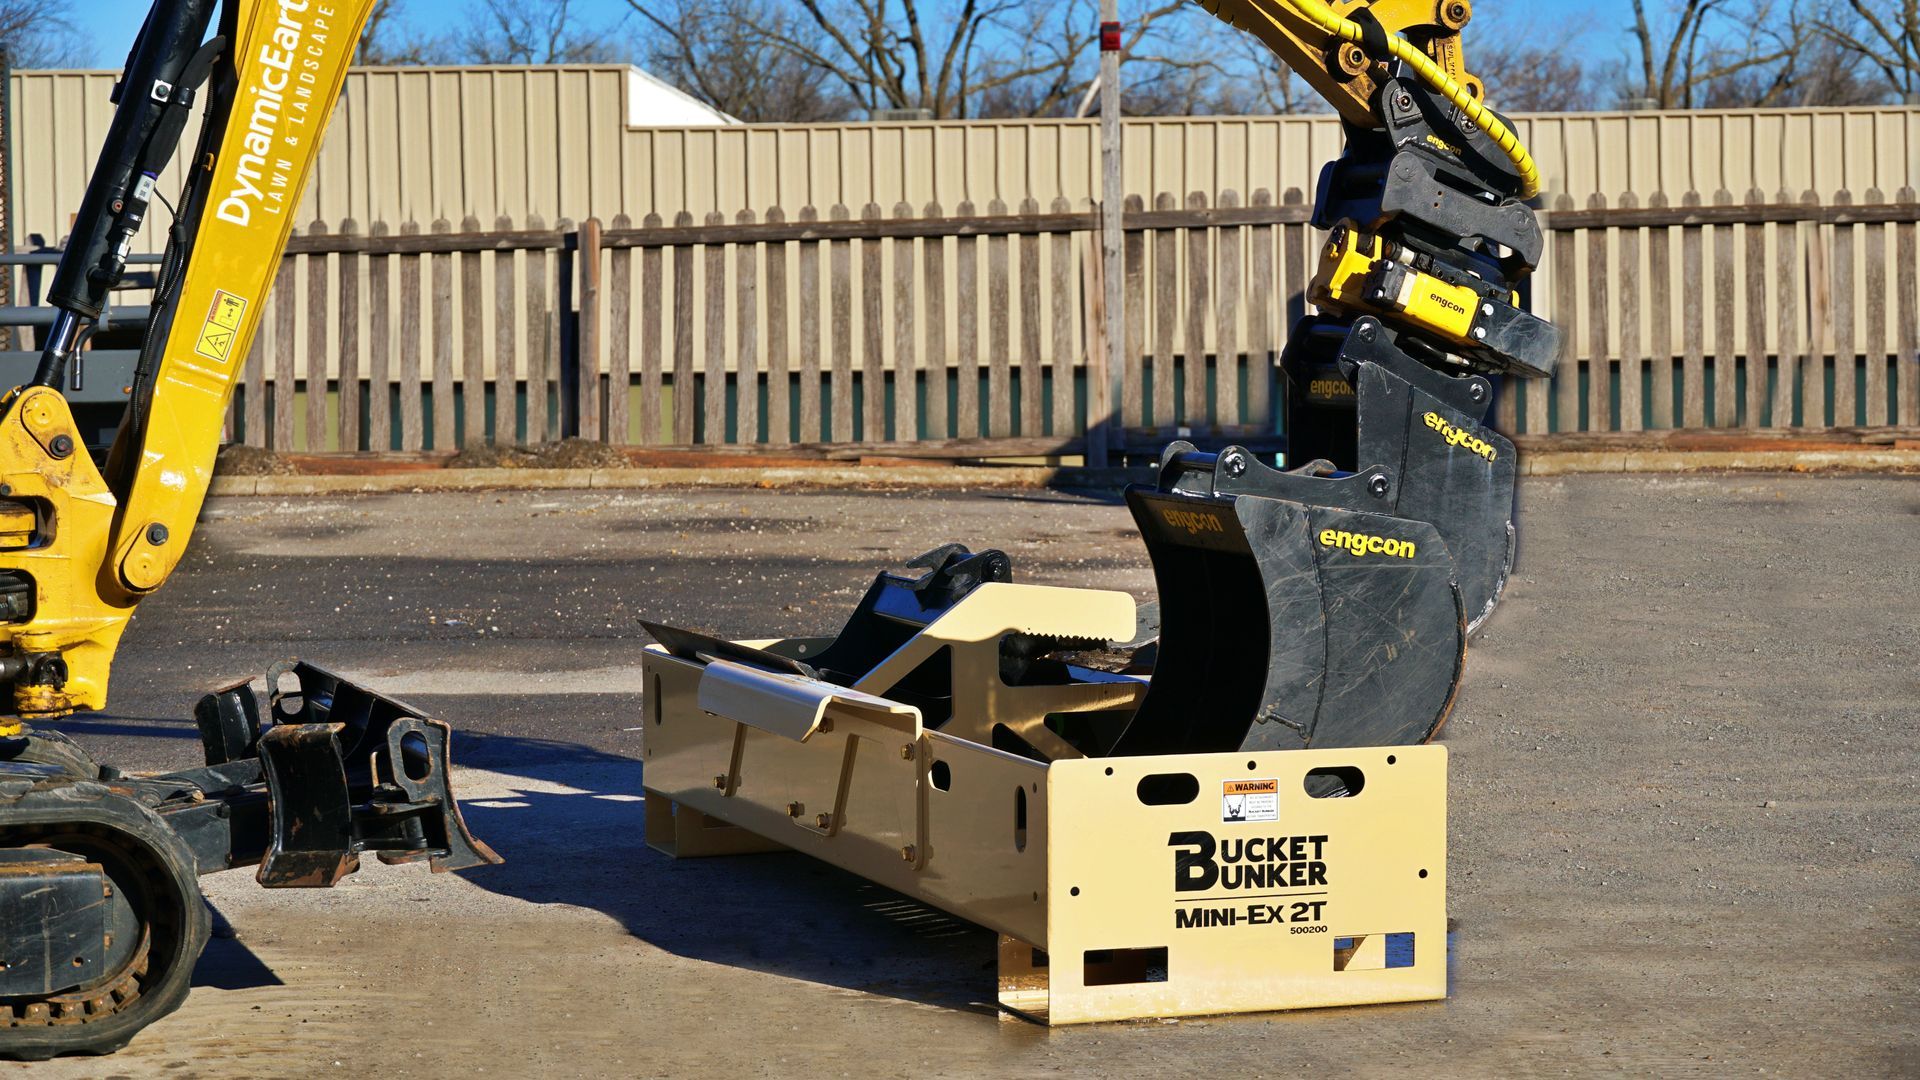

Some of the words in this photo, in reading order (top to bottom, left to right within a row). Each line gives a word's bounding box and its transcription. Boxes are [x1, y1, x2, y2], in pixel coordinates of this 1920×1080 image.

[288, 5, 334, 124] LANDSCAPE
[216, 0, 309, 227] DynamicEart
[285, 137, 298, 146] &
[1426, 134, 1462, 156] engcon
[263, 159, 293, 214] LAWN
[1430, 293, 1465, 315] engcon
[1423, 412, 1497, 461] engcon
[1162, 509, 1224, 535] engcon
[1320, 529, 1415, 558] engcon
[1235, 782, 1274, 791] WARNING
[1168, 830, 1328, 892] BUCKET
[1175, 904, 1284, 928] MINI-EX
[1290, 901, 1327, 922] 2T
[1290, 925, 1328, 935] 500200
